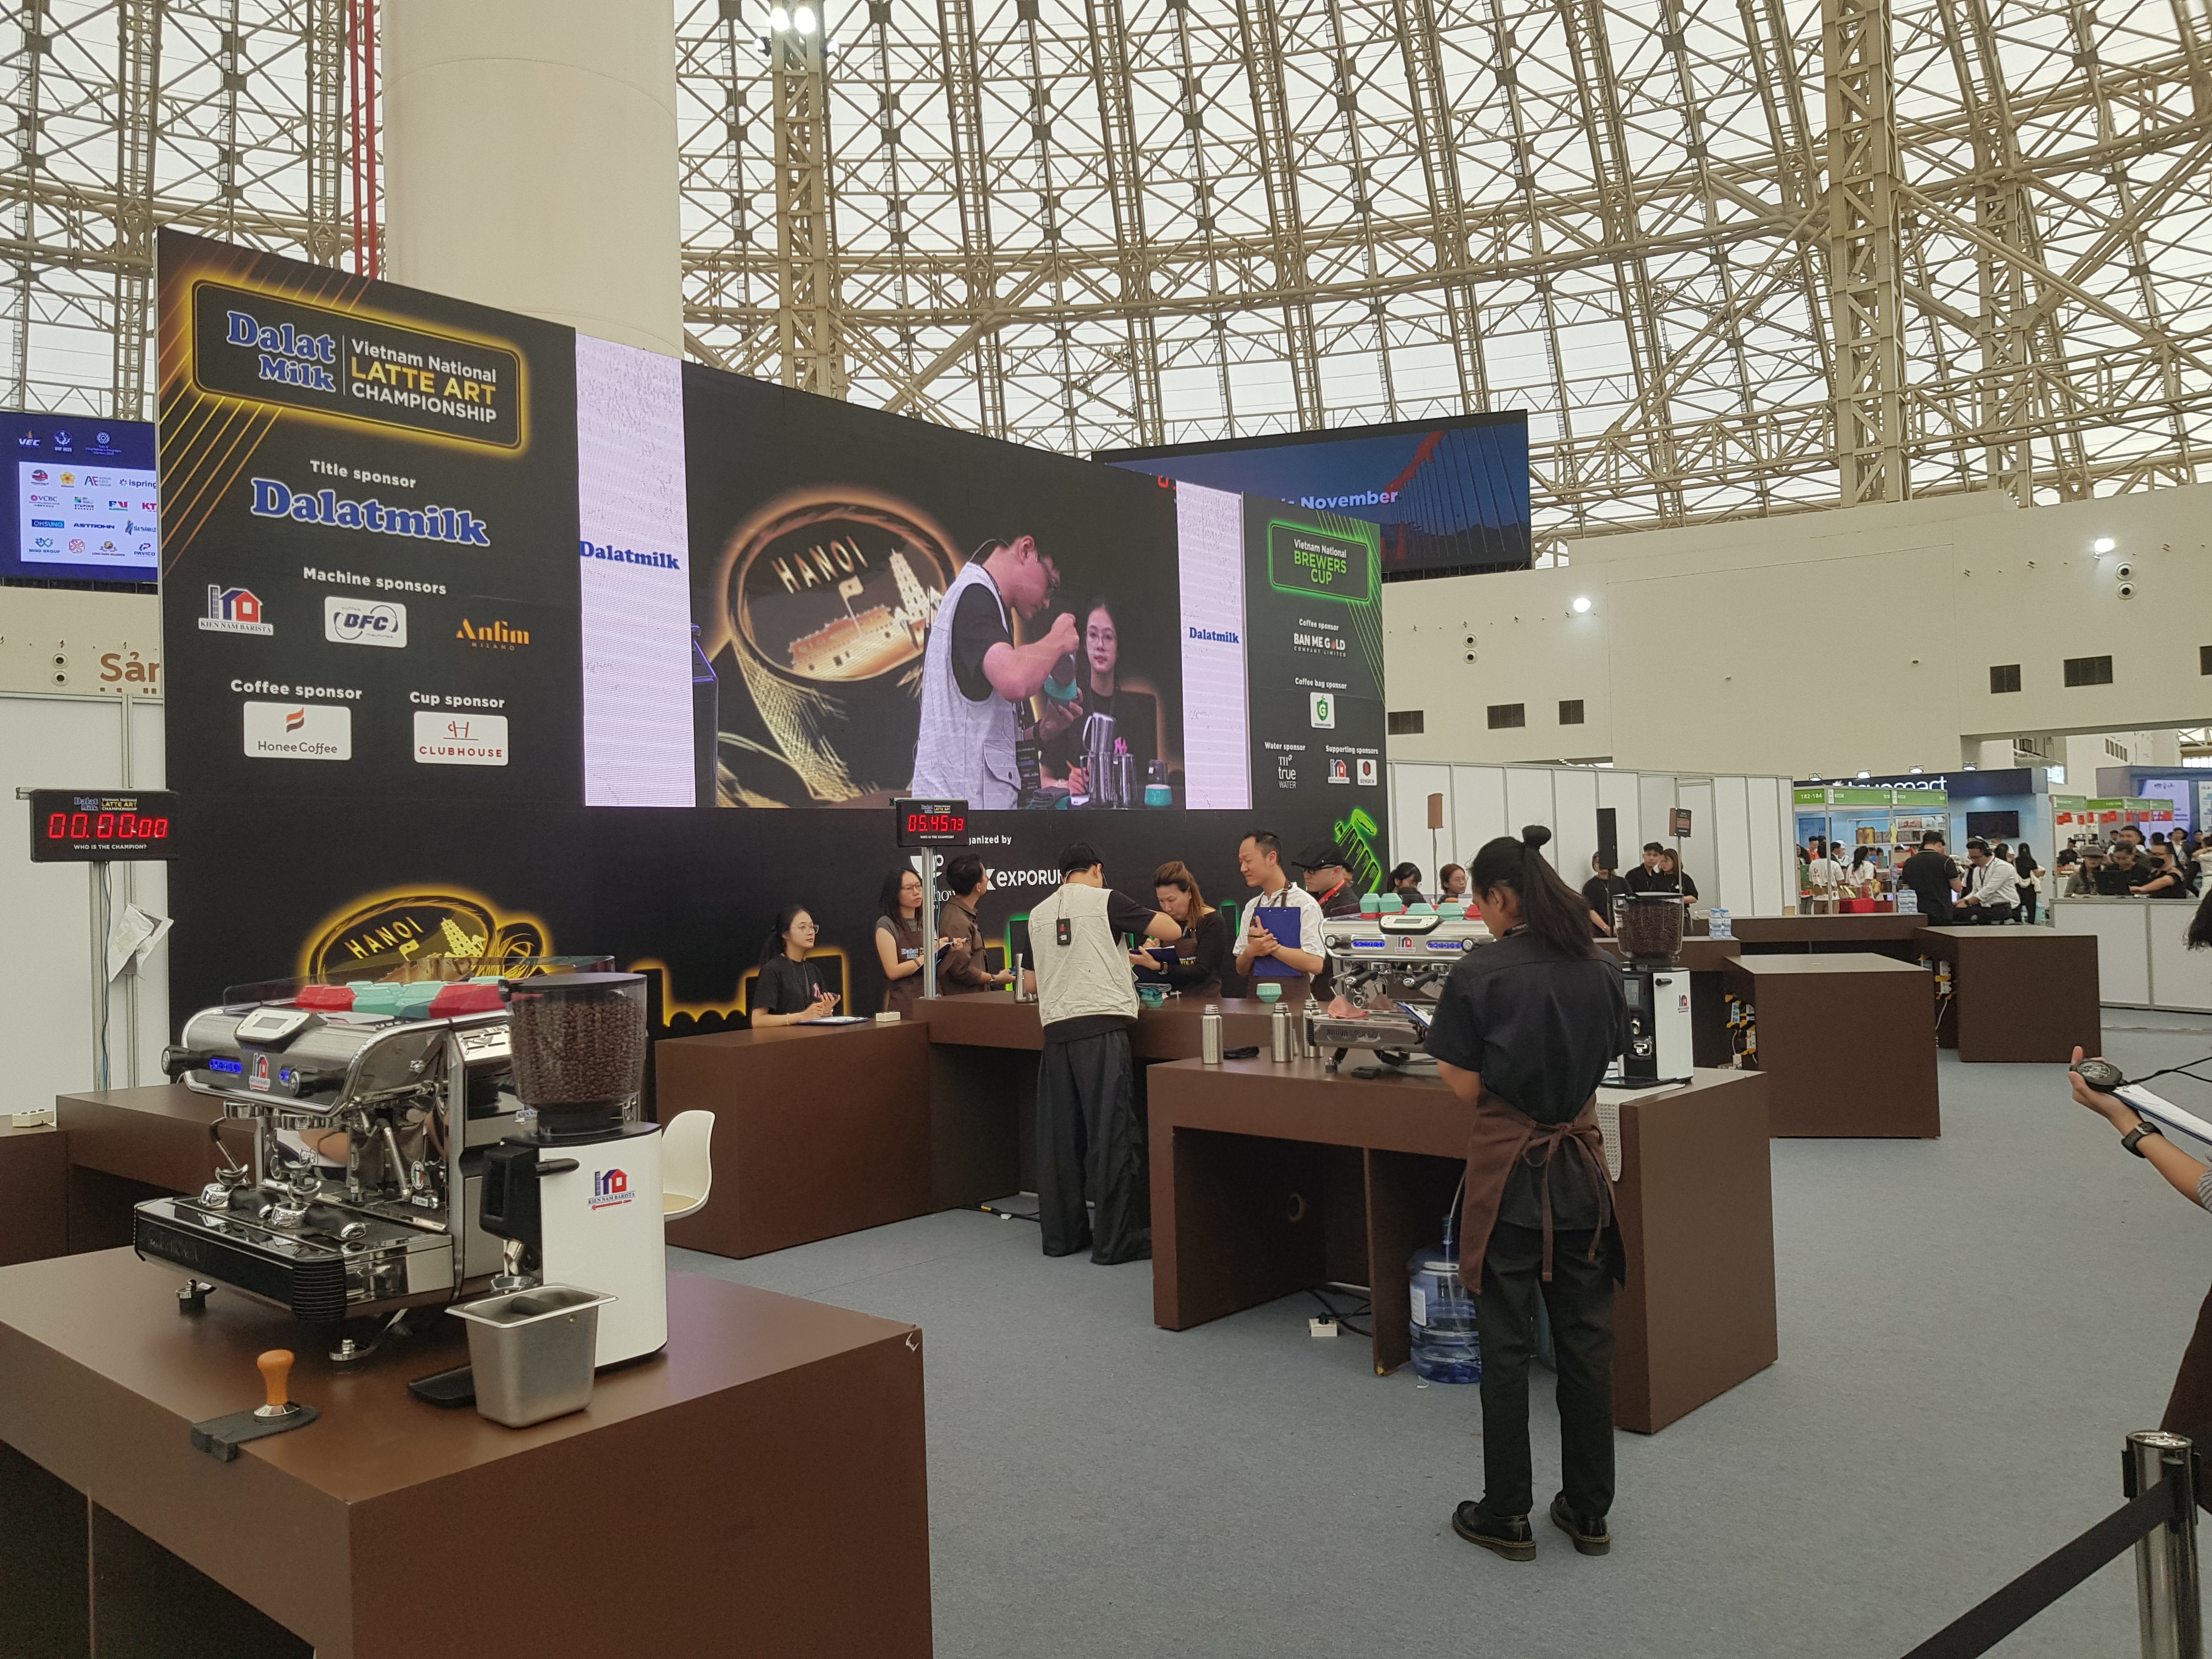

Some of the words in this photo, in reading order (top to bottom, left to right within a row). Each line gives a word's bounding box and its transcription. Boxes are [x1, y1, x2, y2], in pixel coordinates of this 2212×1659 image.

[227, 310, 336, 364] Dalat
[352, 338, 423, 368] Vietnam
[428, 356, 496, 383] National
[258, 354, 336, 392] Milk
[351, 357, 436, 393] LATTE
[443, 377, 496, 405] ART
[352, 382, 496, 423] CHAMPIONSHIP
[309, 459, 348, 477] Title
[353, 468, 416, 488] sponsor
[1301, 490, 1398, 510] November
[251, 477, 490, 546] Dalatmilk
[580, 541, 680, 569] Dalatmilk
[1294, 539, 1321, 552] Vietnam
[1322, 545, 1347, 558] National
[771, 535, 869, 594] HANOI
[1294, 550, 1347, 574] BREWERS
[303, 567, 371, 586] Machine
[376, 578, 447, 595] sponsors
[1311, 568, 1333, 585] CUP
[343, 613, 388, 631] BFC
[456, 618, 530, 645] Anfim
[1299, 618, 1317, 628] Coffee
[1318, 623, 1339, 631] sponsor
[1189, 627, 1239, 644] Dalatmilk
[1294, 633, 1311, 646] BAN
[1312, 635, 1323, 648] ME
[471, 642, 515, 651] MILANO
[230, 680, 290, 695] Coffee
[295, 685, 363, 699] sponsor
[1295, 677, 1313, 686] Coffee
[1314, 679, 1325, 689] bag
[410, 691, 440, 706] Cup
[445, 696, 505, 708] sponsor
[419, 746, 502, 757] CLUBHOUSE
[1265, 742, 1282, 750] Water
[1325, 745, 1356, 754] Supporting
[1278, 766, 1296, 780] true
[1279, 781, 1297, 789] WATER
[1002, 835, 1012, 845] by
[344, 916, 424, 959] HANOI
